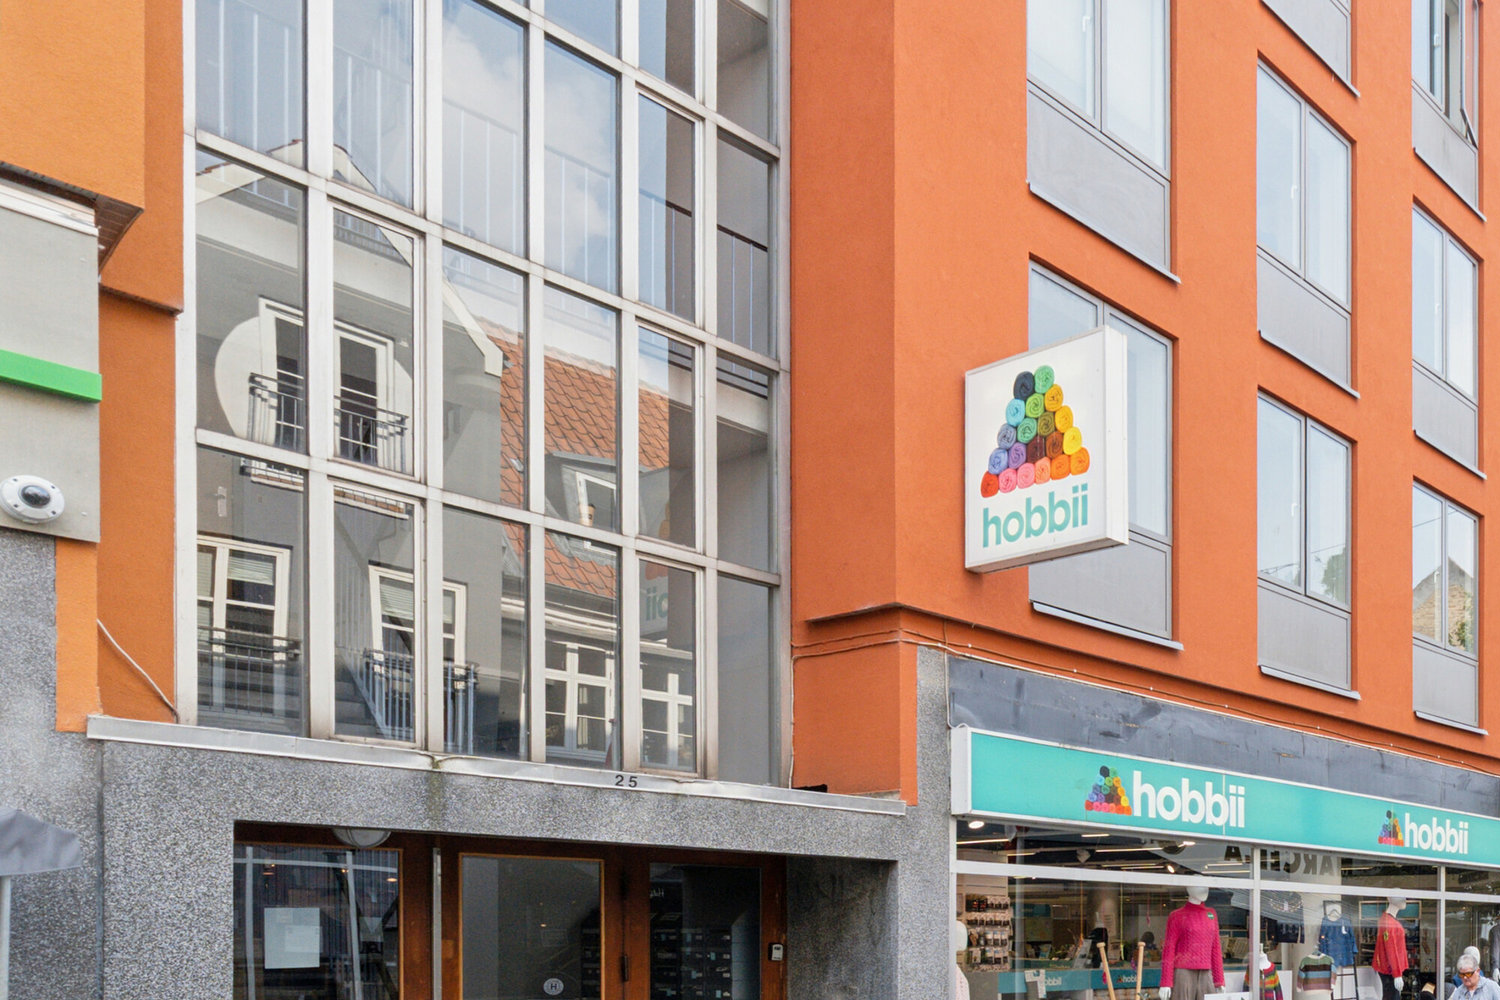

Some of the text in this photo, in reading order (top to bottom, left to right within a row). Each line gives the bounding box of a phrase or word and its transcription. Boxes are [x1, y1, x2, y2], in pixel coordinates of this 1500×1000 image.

[982, 482, 1089, 548] hobbii
[614, 774, 639, 789] 25
[1132, 769, 1246, 829] hobbii
[1404, 812, 1470, 855] hobbii
